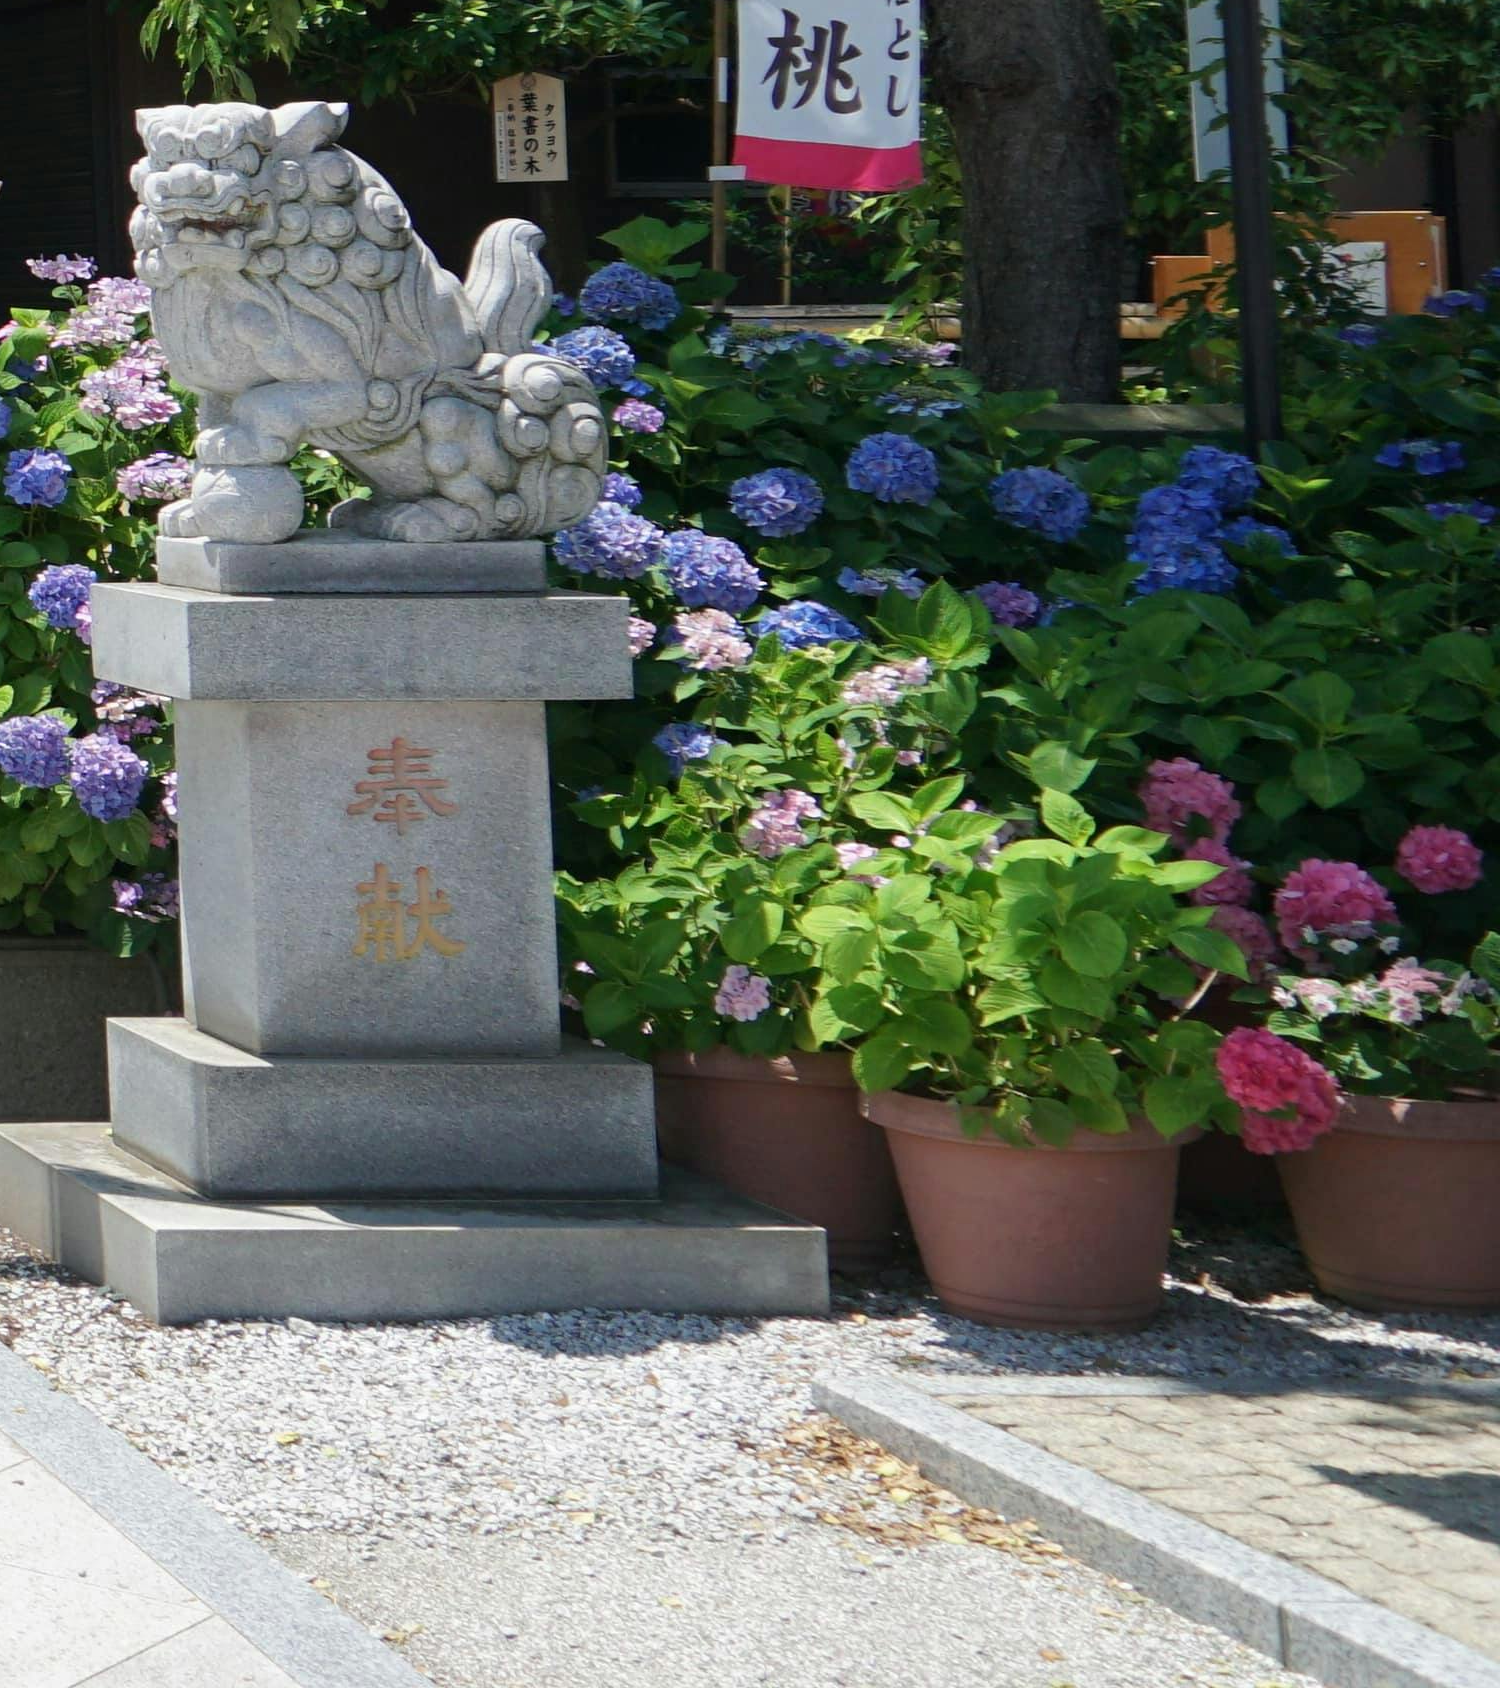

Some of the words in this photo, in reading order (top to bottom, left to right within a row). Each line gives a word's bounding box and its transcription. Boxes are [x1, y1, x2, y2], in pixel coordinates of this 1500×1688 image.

[520, 92, 541, 175] 葉書の木
[544, 103, 558, 162] タラヨウ
[347, 736, 467, 963] 奉献
